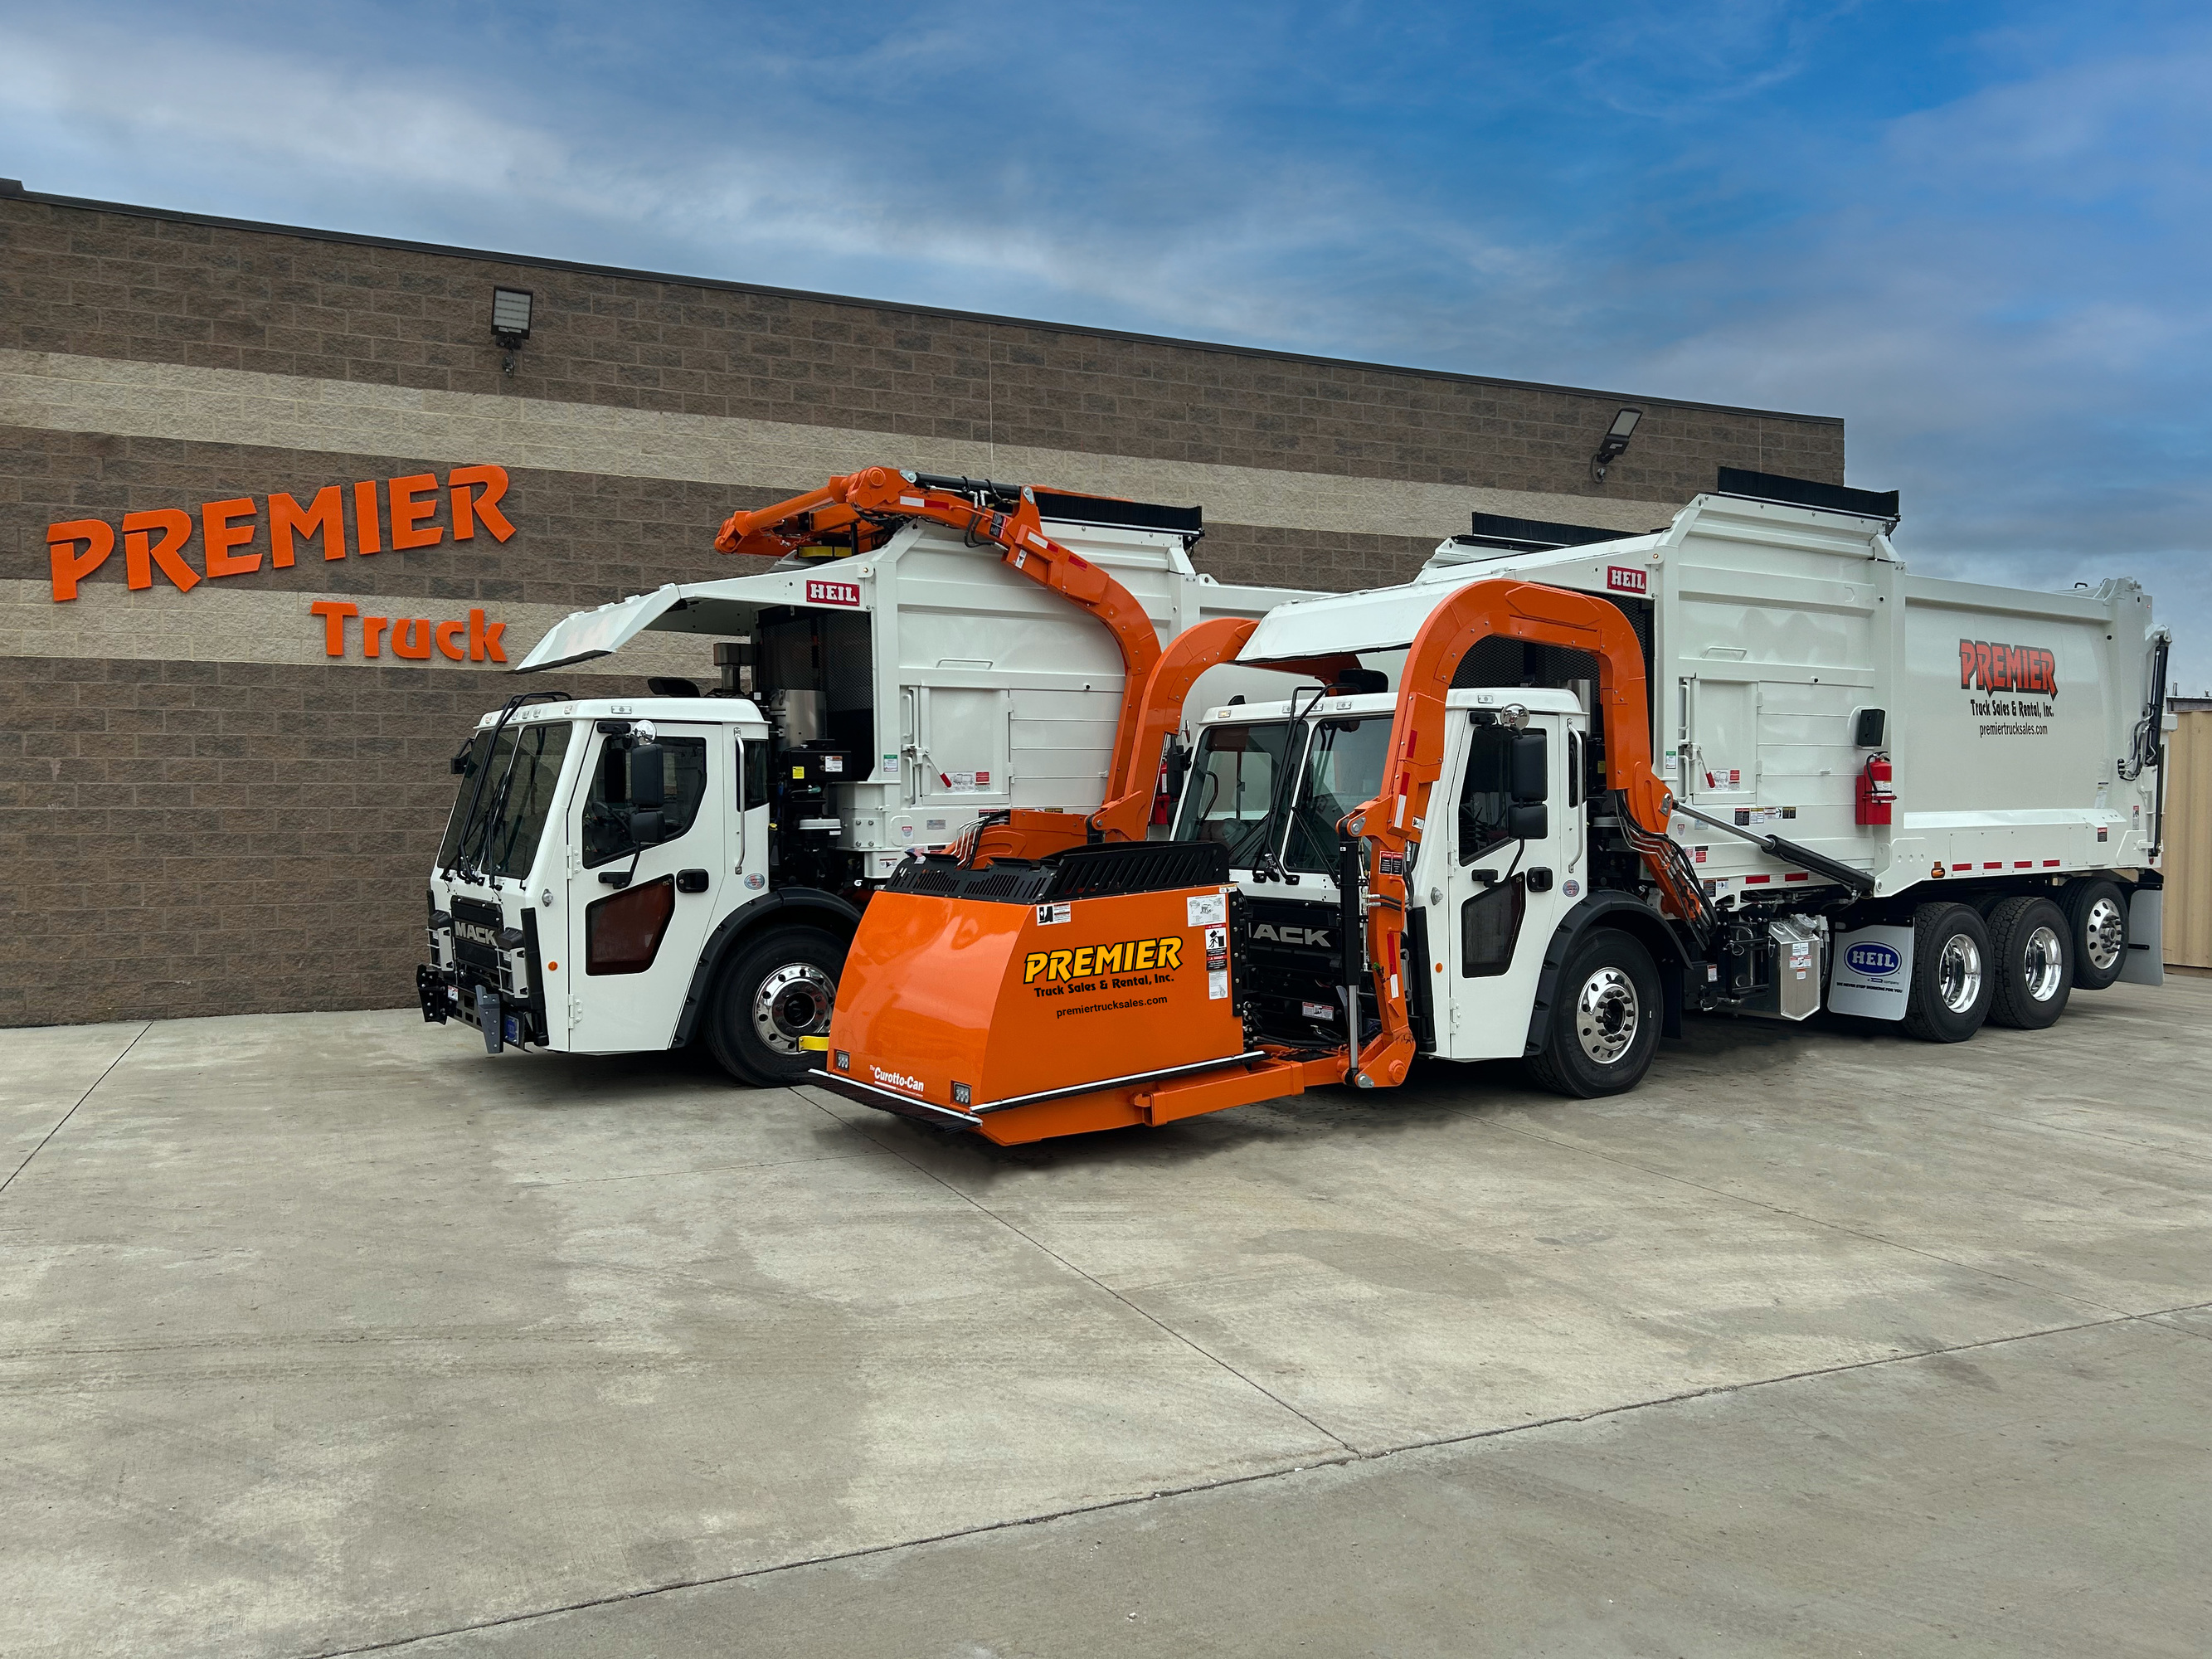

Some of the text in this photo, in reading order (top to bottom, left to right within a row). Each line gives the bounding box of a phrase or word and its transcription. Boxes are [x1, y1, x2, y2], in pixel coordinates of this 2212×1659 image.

[46, 465, 517, 602] PREMIER
[1612, 569, 1646, 590] HEIL
[810, 583, 858, 602] HEIL
[310, 601, 508, 662] Truck
[1959, 638, 2058, 702] PREMIER
[1970, 699, 2054, 718] Truck Sales & Rental, Inc.
[1979, 722, 2048, 738] premiertrucksales.com
[455, 921, 498, 946] MACK
[1247, 922, 1331, 947] ACK
[1023, 936, 1184, 985] PREMIER
[1852, 951, 1894, 967] HEIL
[1033, 973, 1174, 998] Truck Sales & Rental, Inc.
[1056, 996, 1168, 1019] premiertrucksales.com
[873, 1067, 924, 1092] Curotto-Can
